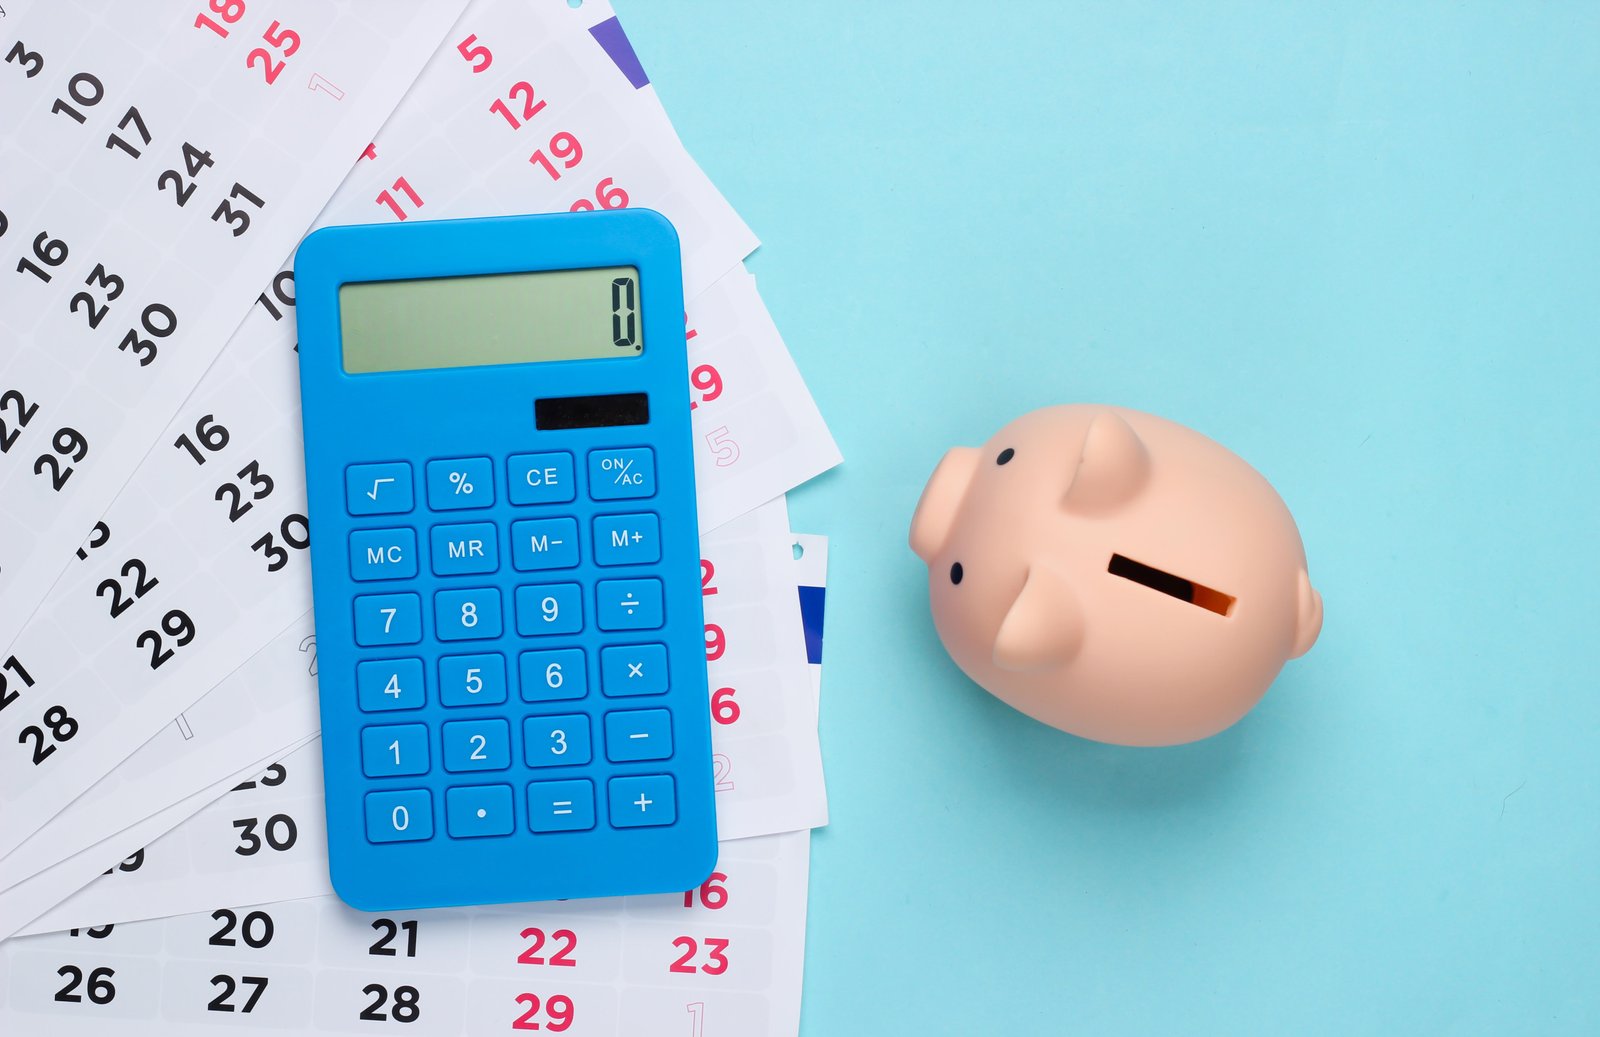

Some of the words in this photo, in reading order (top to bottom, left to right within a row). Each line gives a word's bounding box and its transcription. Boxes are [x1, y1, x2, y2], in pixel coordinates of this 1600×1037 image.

[5, 41, 43, 78] 3
[457, 34, 492, 73] 5
[52, 73, 104, 124] 10
[16, 231, 68, 283] 16
[106, 106, 151, 159] 17
[195, 0, 245, 38] 18
[376, 177, 424, 221] 11
[490, 82, 546, 130] 12
[530, 132, 582, 180] 19
[0, 390, 39, 453] 22
[70, 263, 124, 329] 23
[158, 142, 214, 207] 24
[247, 21, 300, 85] 25
[34, 427, 88, 492] 29
[118, 303, 177, 366] 30
[211, 183, 265, 237] 31
[308, 73, 345, 101] 1
[691, 365, 722, 410] 9
[174, 415, 229, 465] 16
[705, 426, 740, 467] 5
[527, 468, 557, 485] CE
[368, 546, 401, 563] MC
[449, 540, 483, 557] MR
[612, 530, 642, 546] M+
[0, 655, 35, 711] 21
[96, 559, 159, 619] 22
[215, 460, 274, 522] 23
[381, 609, 396, 632] 7
[462, 603, 477, 627] 8
[542, 597, 558, 621] 9
[19, 706, 78, 766] 28
[137, 610, 195, 670] 29
[251, 514, 309, 572] 30
[385, 674, 401, 698] 4
[467, 669, 482, 693] 5
[547, 664, 562, 687] 6
[390, 741, 399, 764] 1
[470, 735, 486, 759] 2
[551, 730, 567, 754] 3
[233, 814, 297, 856] 30
[393, 806, 408, 830] 0
[209, 909, 274, 948] 20
[369, 918, 418, 957] 21
[518, 928, 577, 966] 22
[670, 936, 729, 975] 23
[55, 965, 115, 1004] 26
[208, 975, 268, 1013] 27
[360, 984, 419, 1023] 28
[512, 993, 574, 1032] 29
[687, 1002, 704, 1037] 1
